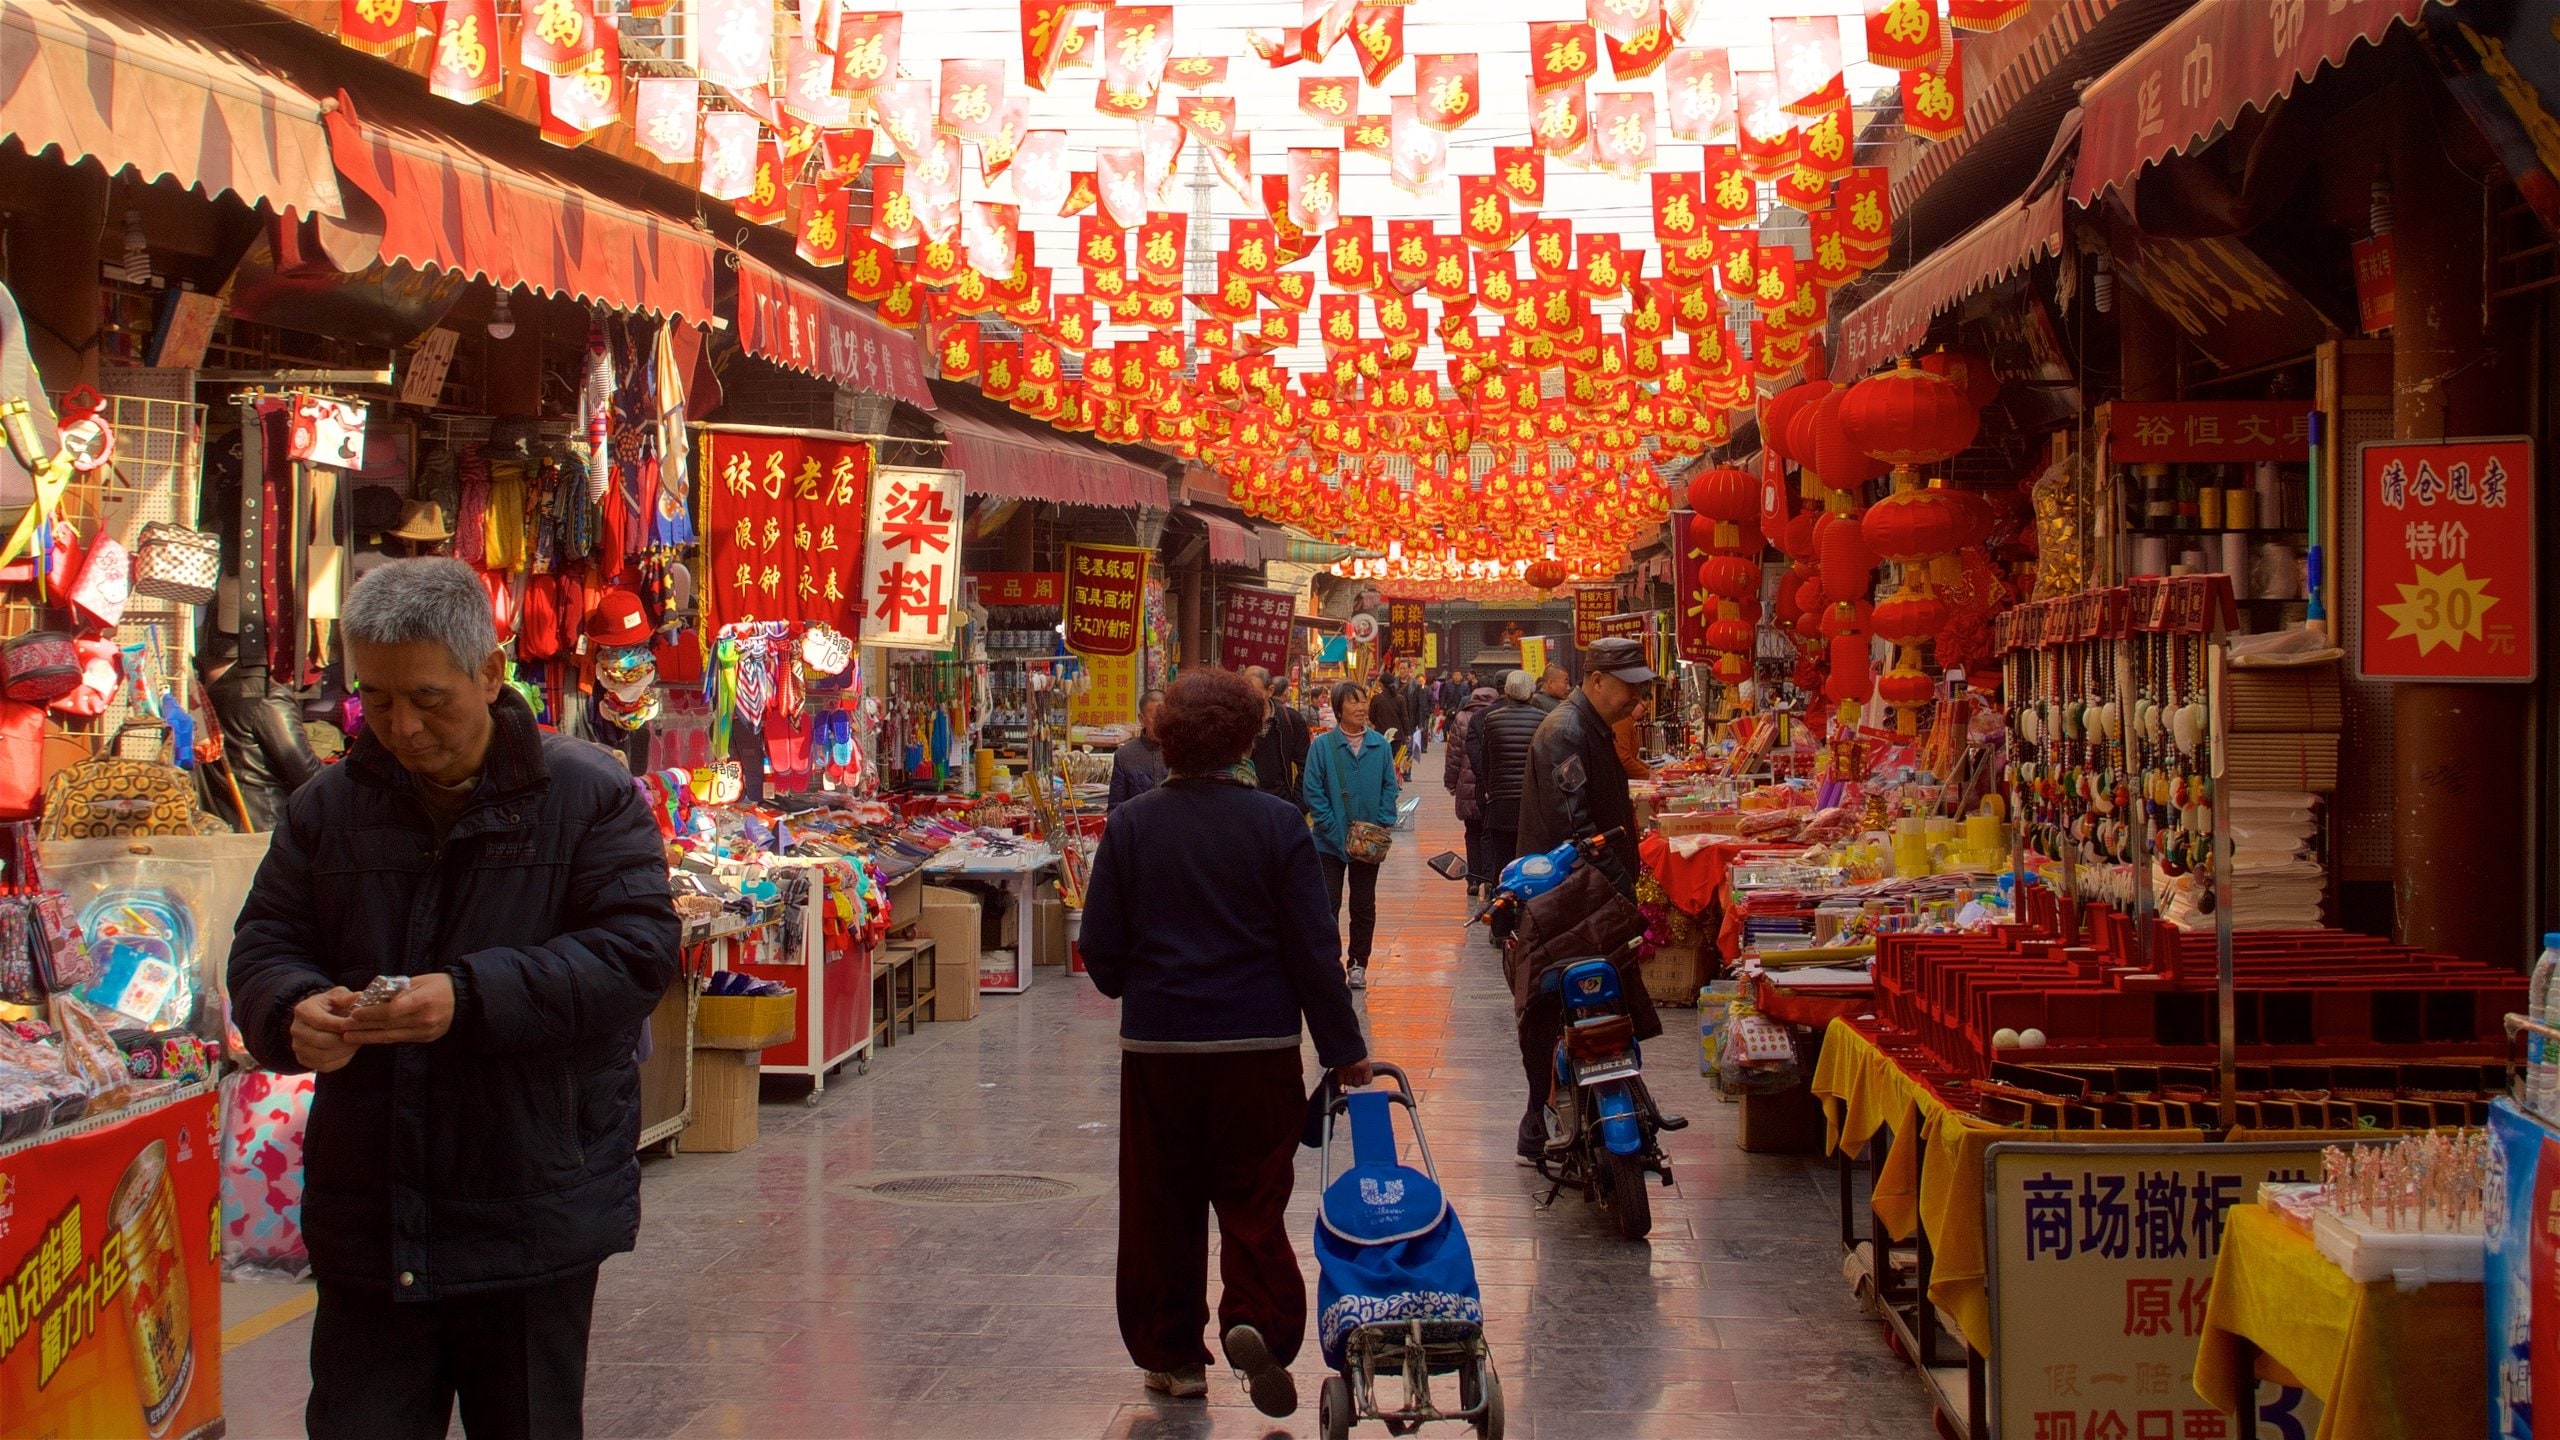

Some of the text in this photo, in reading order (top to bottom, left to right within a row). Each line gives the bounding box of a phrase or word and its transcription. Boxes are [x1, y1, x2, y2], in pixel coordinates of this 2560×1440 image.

[535, 0, 583, 48] 福
[1357, 17, 1392, 61] 福
[1882, 0, 1930, 44] 福
[439, 13, 487, 78] 福
[844, 33, 888, 80] 福
[1542, 36, 1588, 74] 福
[1174, 59, 1214, 76] 福
[1784, 40, 1830, 94] 福
[950, 84, 992, 124] 福
[1310, 83, 1349, 115] 福
[1427, 74, 1470, 116] 福
[1683, 71, 1723, 121] 福
[1912, 72, 1954, 121] 福
[2135, 35, 2213, 148] 丝巾
[648, 101, 688, 151] 福
[887, 110, 920, 150] 福
[1191, 107, 1227, 136] 福
[1539, 95, 1578, 138] 福
[1608, 112, 1648, 156] 福
[1748, 96, 1787, 146] 福
[1355, 125, 1391, 149] 福
[1807, 111, 1846, 161] 福
[916, 139, 950, 185] 福
[1505, 162, 1537, 194] 福
[1107, 169, 1141, 212] 福
[1301, 171, 1334, 216] 福
[1714, 167, 1750, 211] 福
[882, 191, 914, 231] 福
[1469, 194, 1503, 235] 福
[1661, 193, 1695, 233] 福
[1849, 190, 1883, 233] 福
[806, 208, 837, 251] 福
[924, 235, 955, 272] 福
[1087, 234, 1118, 264] 福
[1145, 230, 1177, 268] 福
[1237, 238, 1268, 272] 福
[1332, 236, 1364, 277] 福
[1397, 236, 1428, 267] 福
[1536, 233, 1564, 269] 福
[1725, 247, 1754, 286] 福
[1817, 230, 1847, 270] 福
[852, 248, 881, 287] 福
[956, 267, 985, 302] 福
[1094, 267, 1124, 295] 福
[1434, 254, 1464, 289] 福
[1587, 251, 1618, 288] 福
[1757, 266, 1785, 301] 福
[885, 280, 913, 317] 福
[1223, 275, 1253, 310] 福
[1279, 274, 1305, 299] 福
[1483, 270, 1512, 303] 福
[1679, 286, 1708, 321] 福
[1791, 281, 1817, 318] 福
[1379, 296, 1408, 331] 福
[1514, 296, 1538, 330] 福
[1543, 288, 1571, 326] 福
[1633, 296, 1661, 332] 福
[1059, 313, 1084, 344] 福
[1203, 327, 1228, 347] 福
[1264, 316, 1289, 339] 福
[1329, 309, 1355, 341] 福
[829, 323, 895, 392] 批发零售
[945, 338, 970, 370] 福
[1156, 345, 1180, 369] 福
[1601, 345, 1621, 374] 福
[1633, 336, 1658, 371] 福
[1697, 327, 1722, 362] 福
[988, 358, 1011, 389] 福
[1030, 349, 1055, 379] 福
[1090, 356, 1114, 379] 福
[1121, 358, 1145, 389] 福
[1217, 361, 1241, 391] 福
[1334, 359, 1357, 386] 福
[1357, 351, 1379, 379] 福
[1457, 353, 1482, 383] 福
[1664, 367, 1687, 394] 福
[1387, 378, 1409, 406] 福
[1413, 383, 1435, 409] 福
[1484, 374, 1506, 399] 福
[1517, 382, 1539, 409] 福
[1310, 398, 1331, 417] 福
[1547, 413, 1568, 433] 福
[1634, 404, 1653, 424] 福
[1668, 406, 1687, 426] 福
[1692, 411, 1711, 433] 福
[1240, 423, 1260, 445] 福
[1323, 417, 1340, 441] 福
[1343, 426, 1362, 449] 福
[1452, 427, 1468, 451] 福
[1603, 425, 1621, 448] 福
[2133, 413, 2310, 448] 裕恒文具
[721, 449, 856, 506] 袜子老店
[2381, 456, 2508, 511] 清仓甩卖
[734, 516, 839, 554] 浪莎 雨丝
[2404, 520, 2470, 561] 特价
[874, 481, 953, 635] 染料
[1075, 555, 1137, 580] 笔墨纸砚
[732, 563, 845, 604] 华钟 永春
[976, 577, 1054, 599] 一品阁
[1074, 585, 1135, 610] 画具画材
[1230, 592, 1292, 618] 袜子老店
[2415, 587, 2518, 655] 30 元
[1072, 615, 1132, 641] 手工DIY制作
[1391, 603, 1406, 648] 麻将
[1407, 603, 1423, 647] 染料
[1077, 692, 1129, 707] 偏光镜
[2022, 1170, 2242, 1262] 商场撤柜
[0, 1202, 83, 1359] 补充能量
[39, 1230, 130, 1388] 精力十足
[2034, 1408, 2228, 1440] 现价只要
